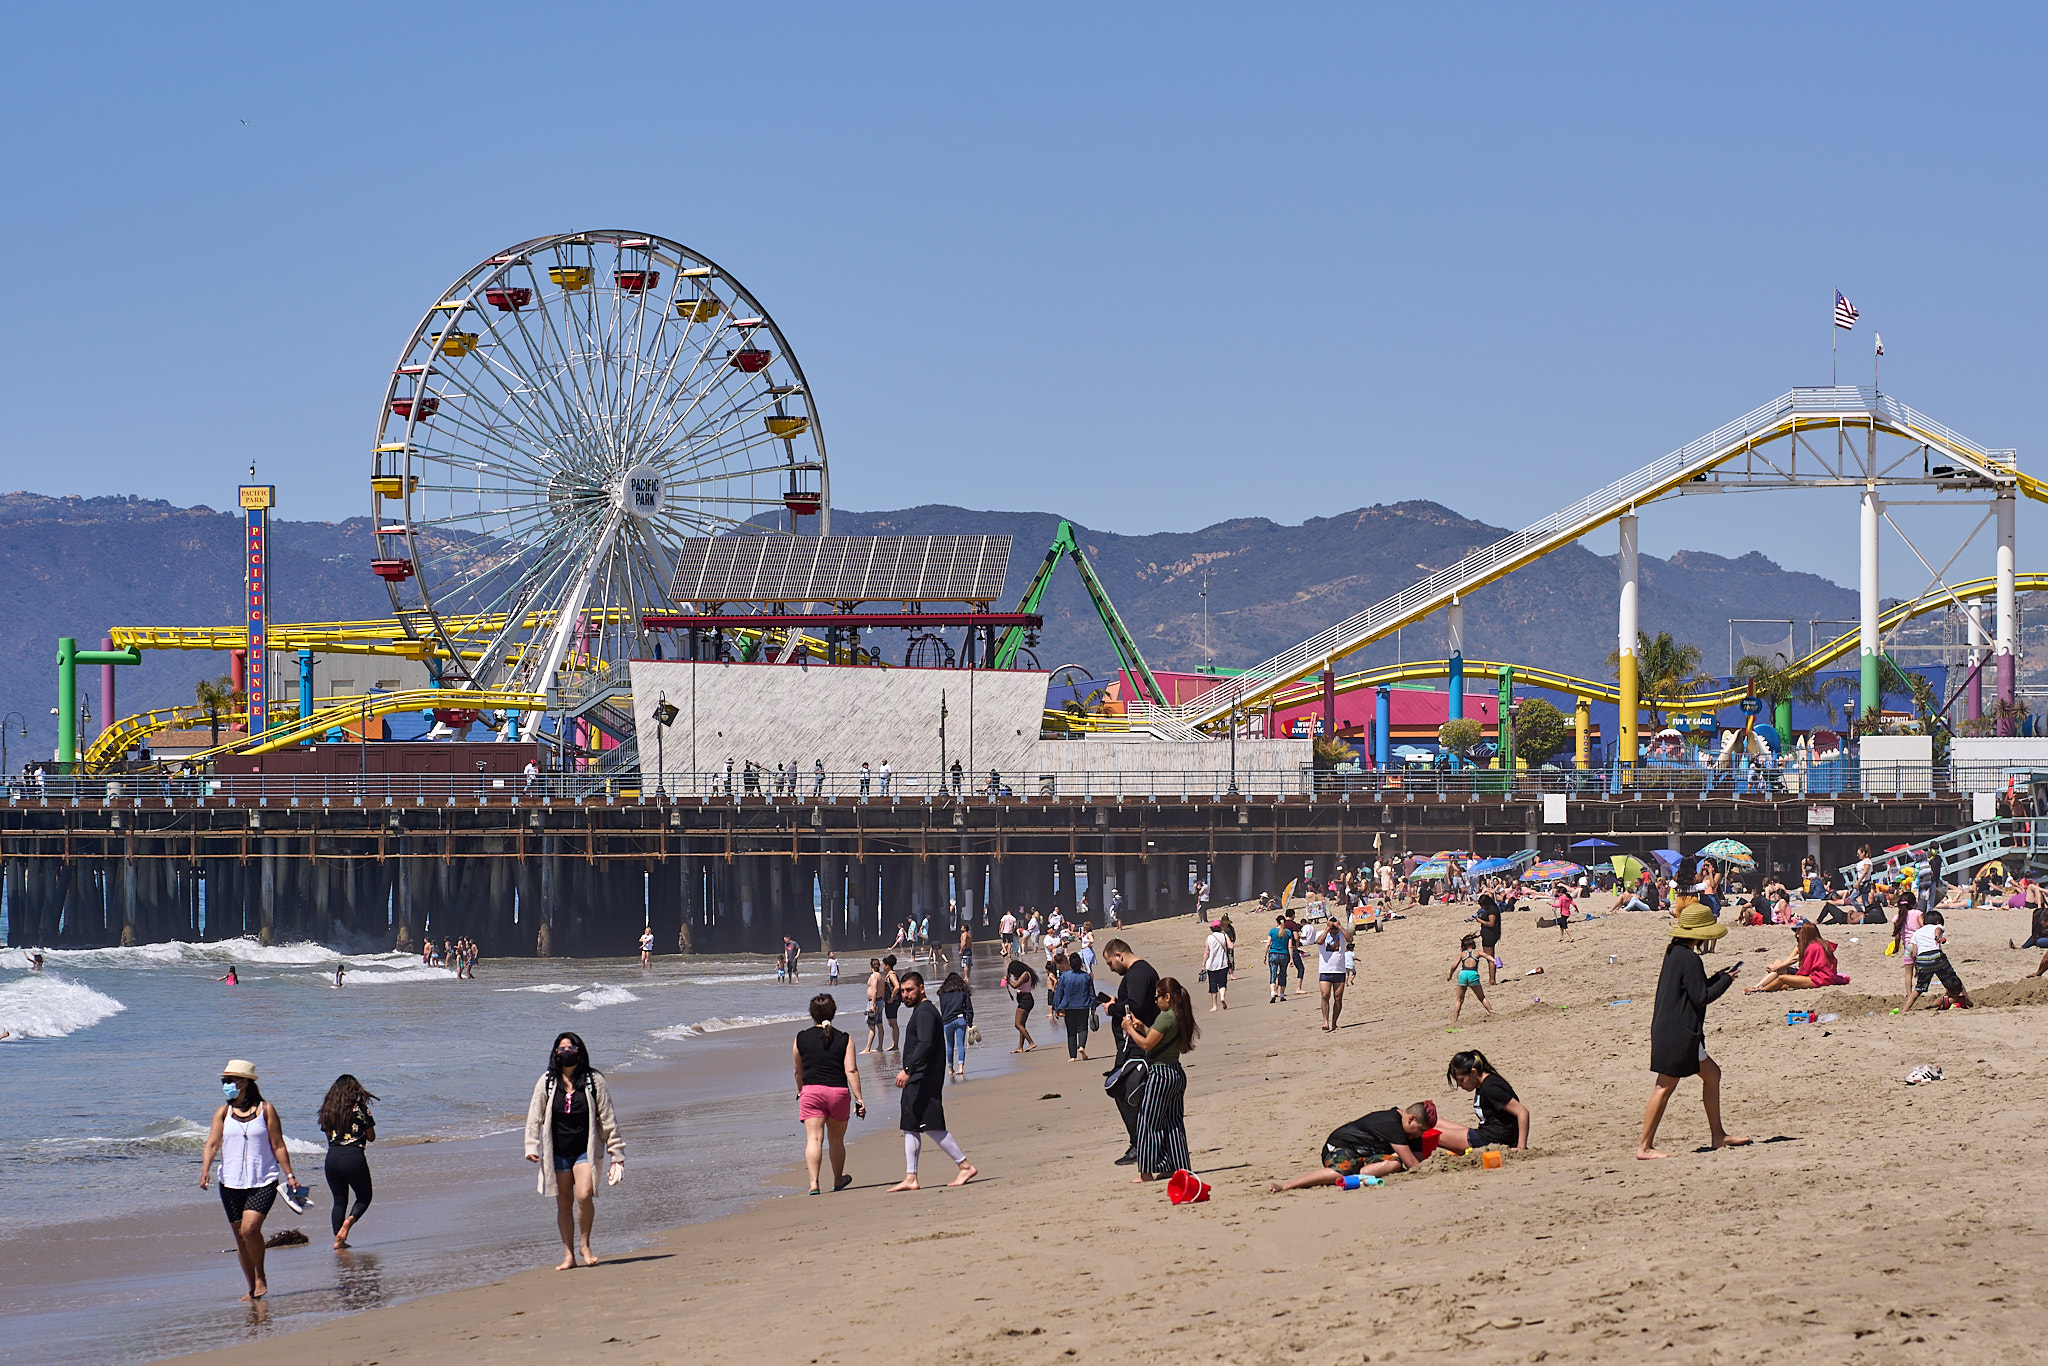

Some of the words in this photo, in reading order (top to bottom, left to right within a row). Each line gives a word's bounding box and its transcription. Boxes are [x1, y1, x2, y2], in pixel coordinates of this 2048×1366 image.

[631, 478, 659, 491] PACIFIC
[635, 492, 655, 506] PARK
[251, 527, 261, 620] PACIFIC
[251, 636, 261, 715] PLUNGE
